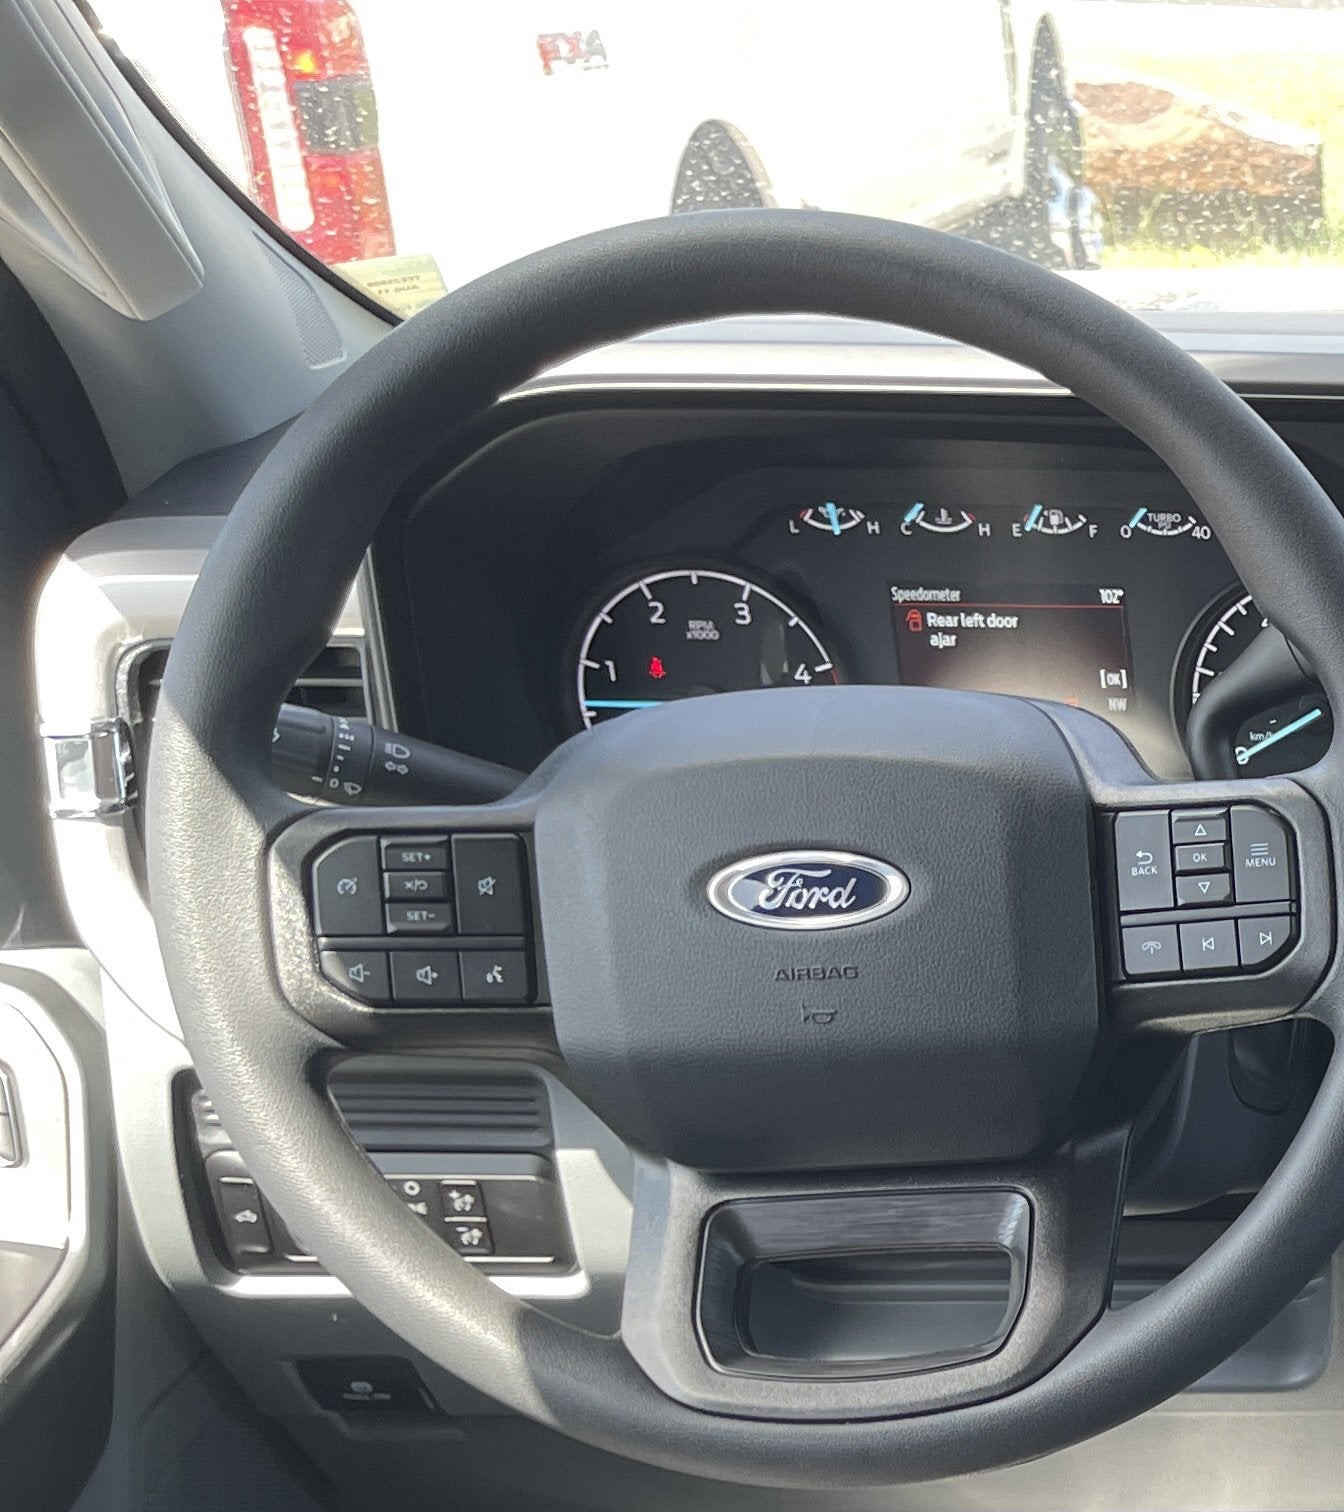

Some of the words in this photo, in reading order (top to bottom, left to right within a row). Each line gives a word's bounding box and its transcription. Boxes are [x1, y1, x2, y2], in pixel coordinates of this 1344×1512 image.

[1147, 512, 1182, 523] TURBO
[789, 519, 800, 534] L
[866, 520, 880, 535] H
[900, 521, 913, 536] C
[977, 523, 991, 537] H
[1012, 523, 1022, 538] E
[1088, 525, 1098, 538] F
[1191, 526, 1211, 540] 40
[891, 586, 961, 603] Speedometer
[648, 601, 667, 625] 2
[733, 602, 752, 625] 3
[926, 612, 958, 628] Rear
[960, 612, 986, 628] left
[986, 614, 1019, 629] door
[688, 619, 716, 631] RPM
[929, 632, 957, 650] ajar
[604, 660, 618, 682] 1
[793, 663, 813, 685] 4
[1108, 698, 1128, 712] NW
[1192, 852, 1208, 863] OK
[1245, 857, 1277, 868] MENU
[1131, 865, 1158, 877] BACK
[758, 868, 858, 911] Ford
[774, 966, 860, 983] AIRBAG
